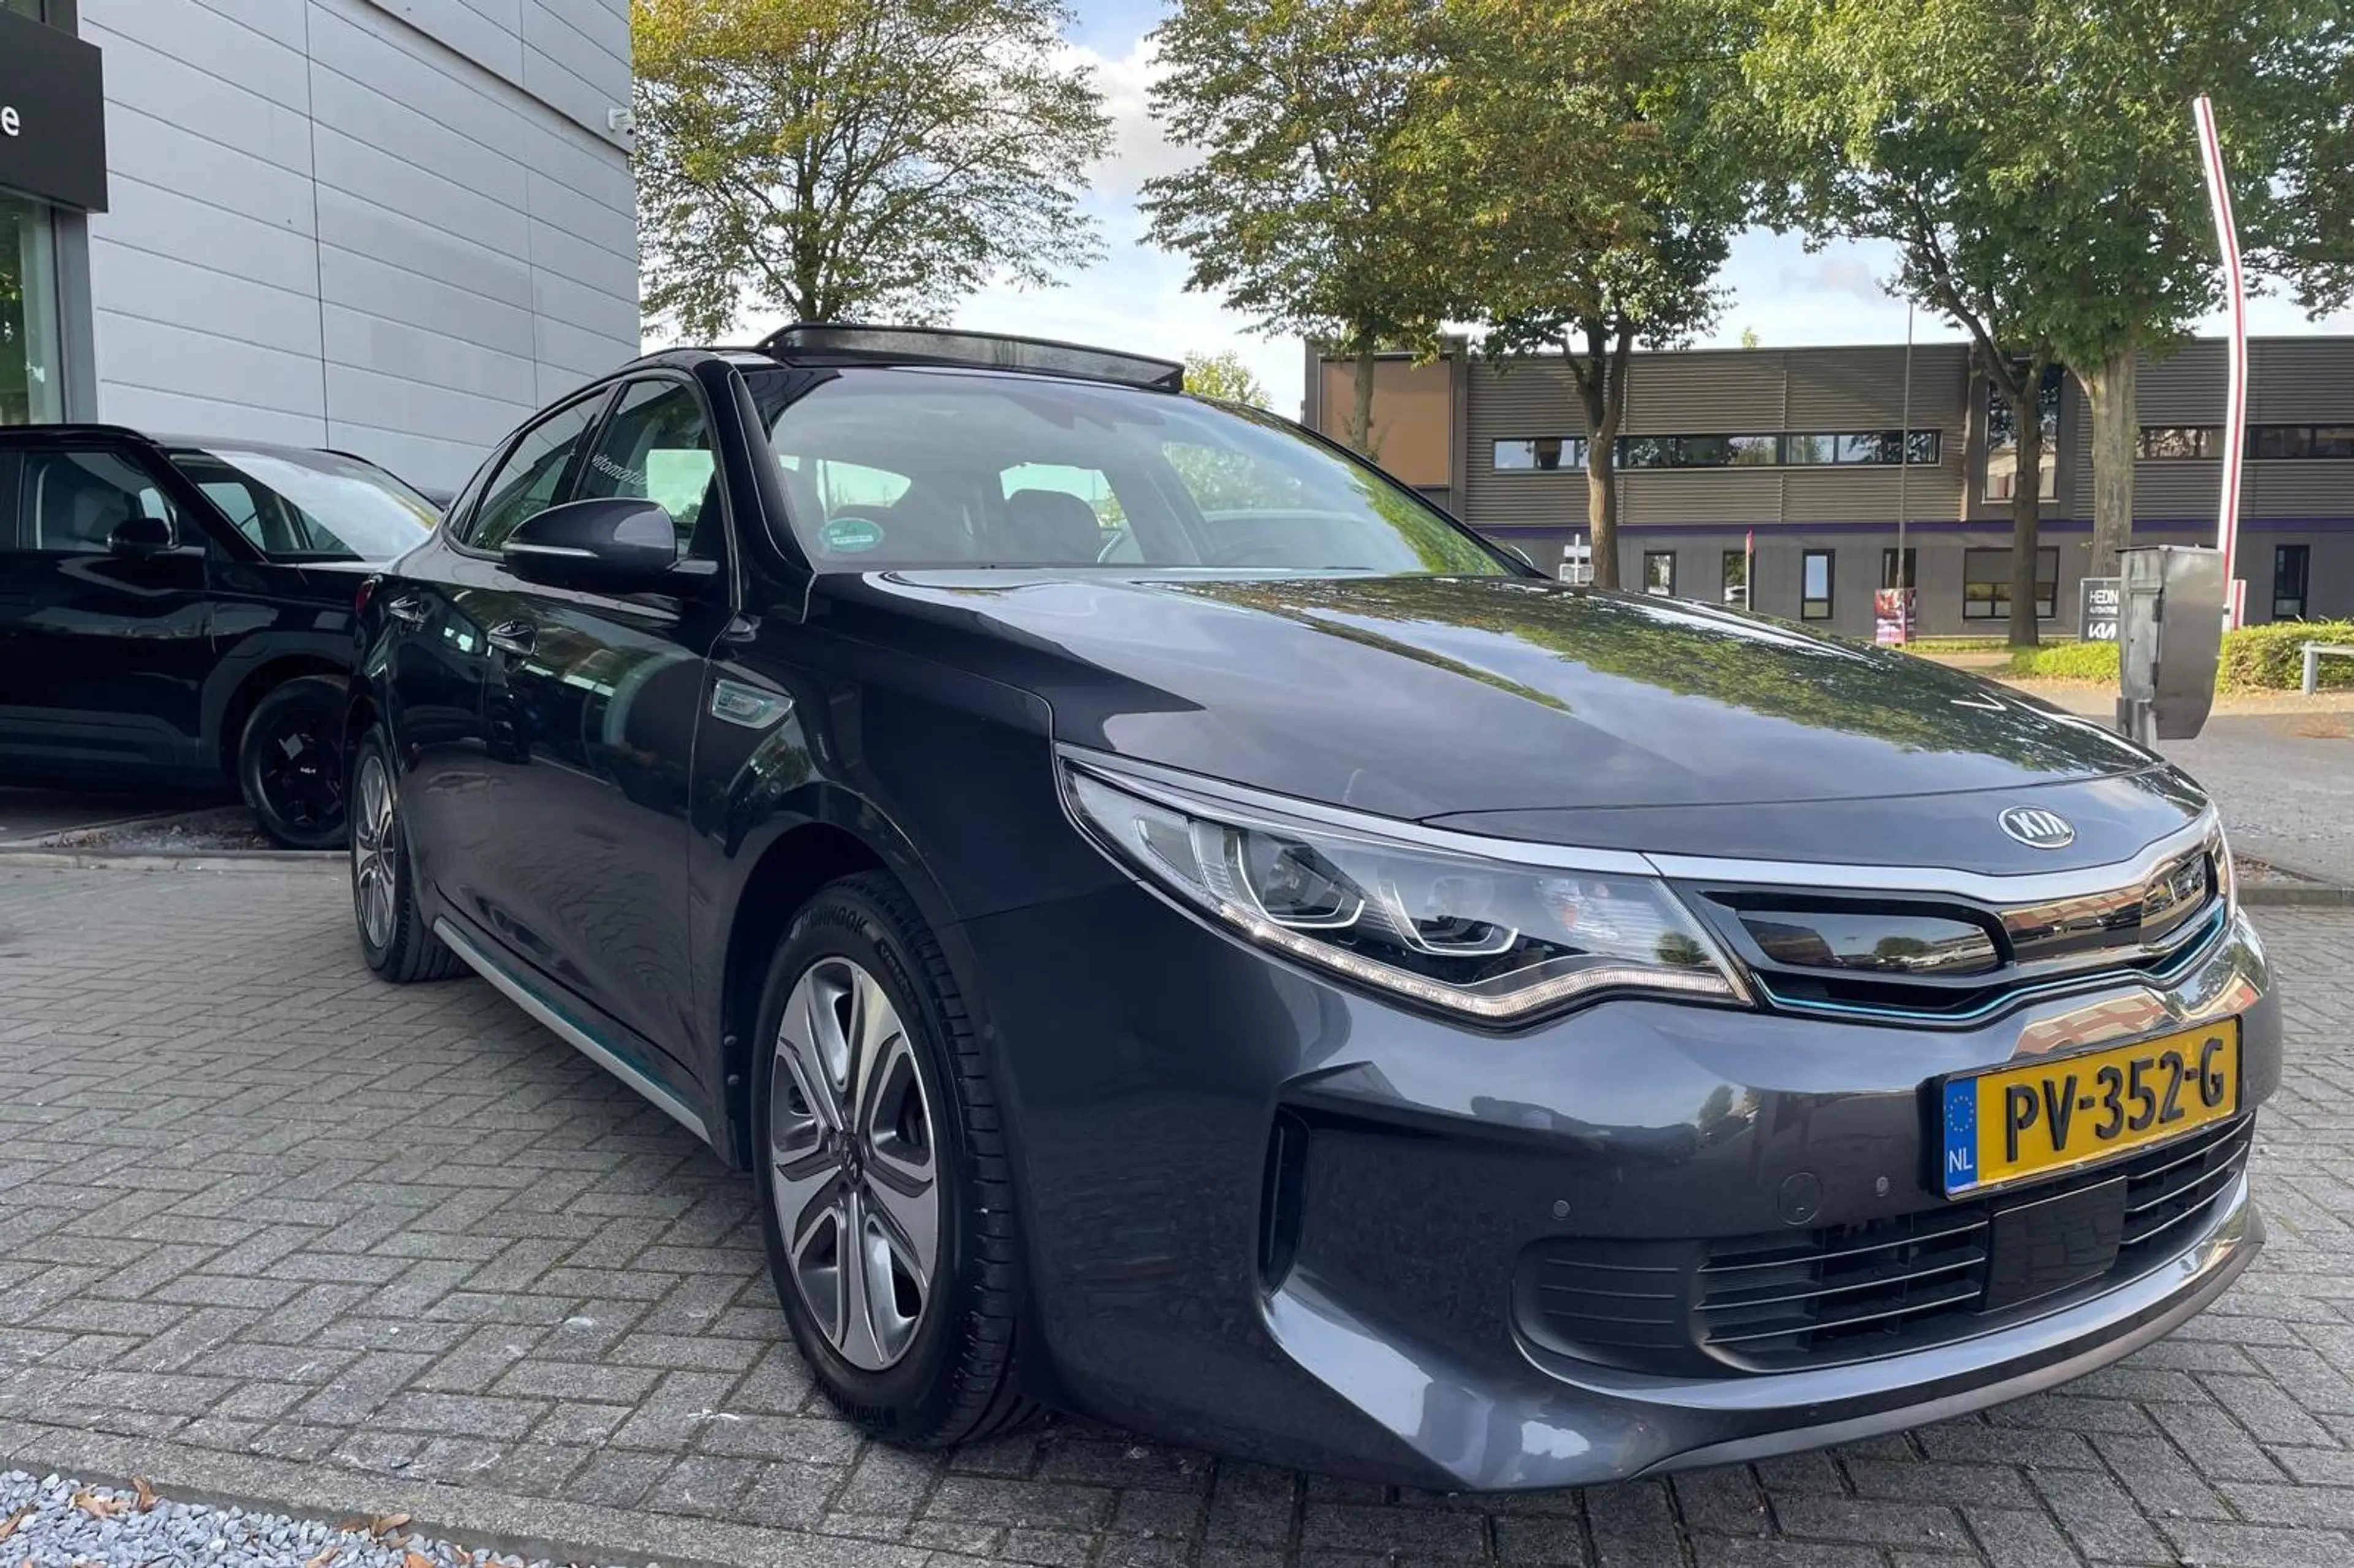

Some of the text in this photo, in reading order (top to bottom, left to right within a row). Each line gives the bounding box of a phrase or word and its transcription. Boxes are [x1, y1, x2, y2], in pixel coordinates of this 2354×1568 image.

[2089, 589, 2119, 604] HEDIN
[2008, 811, 2070, 838] KIA
[2005, 1036, 2225, 1163] PV-352-G
[1948, 1148, 1973, 1174] NL
